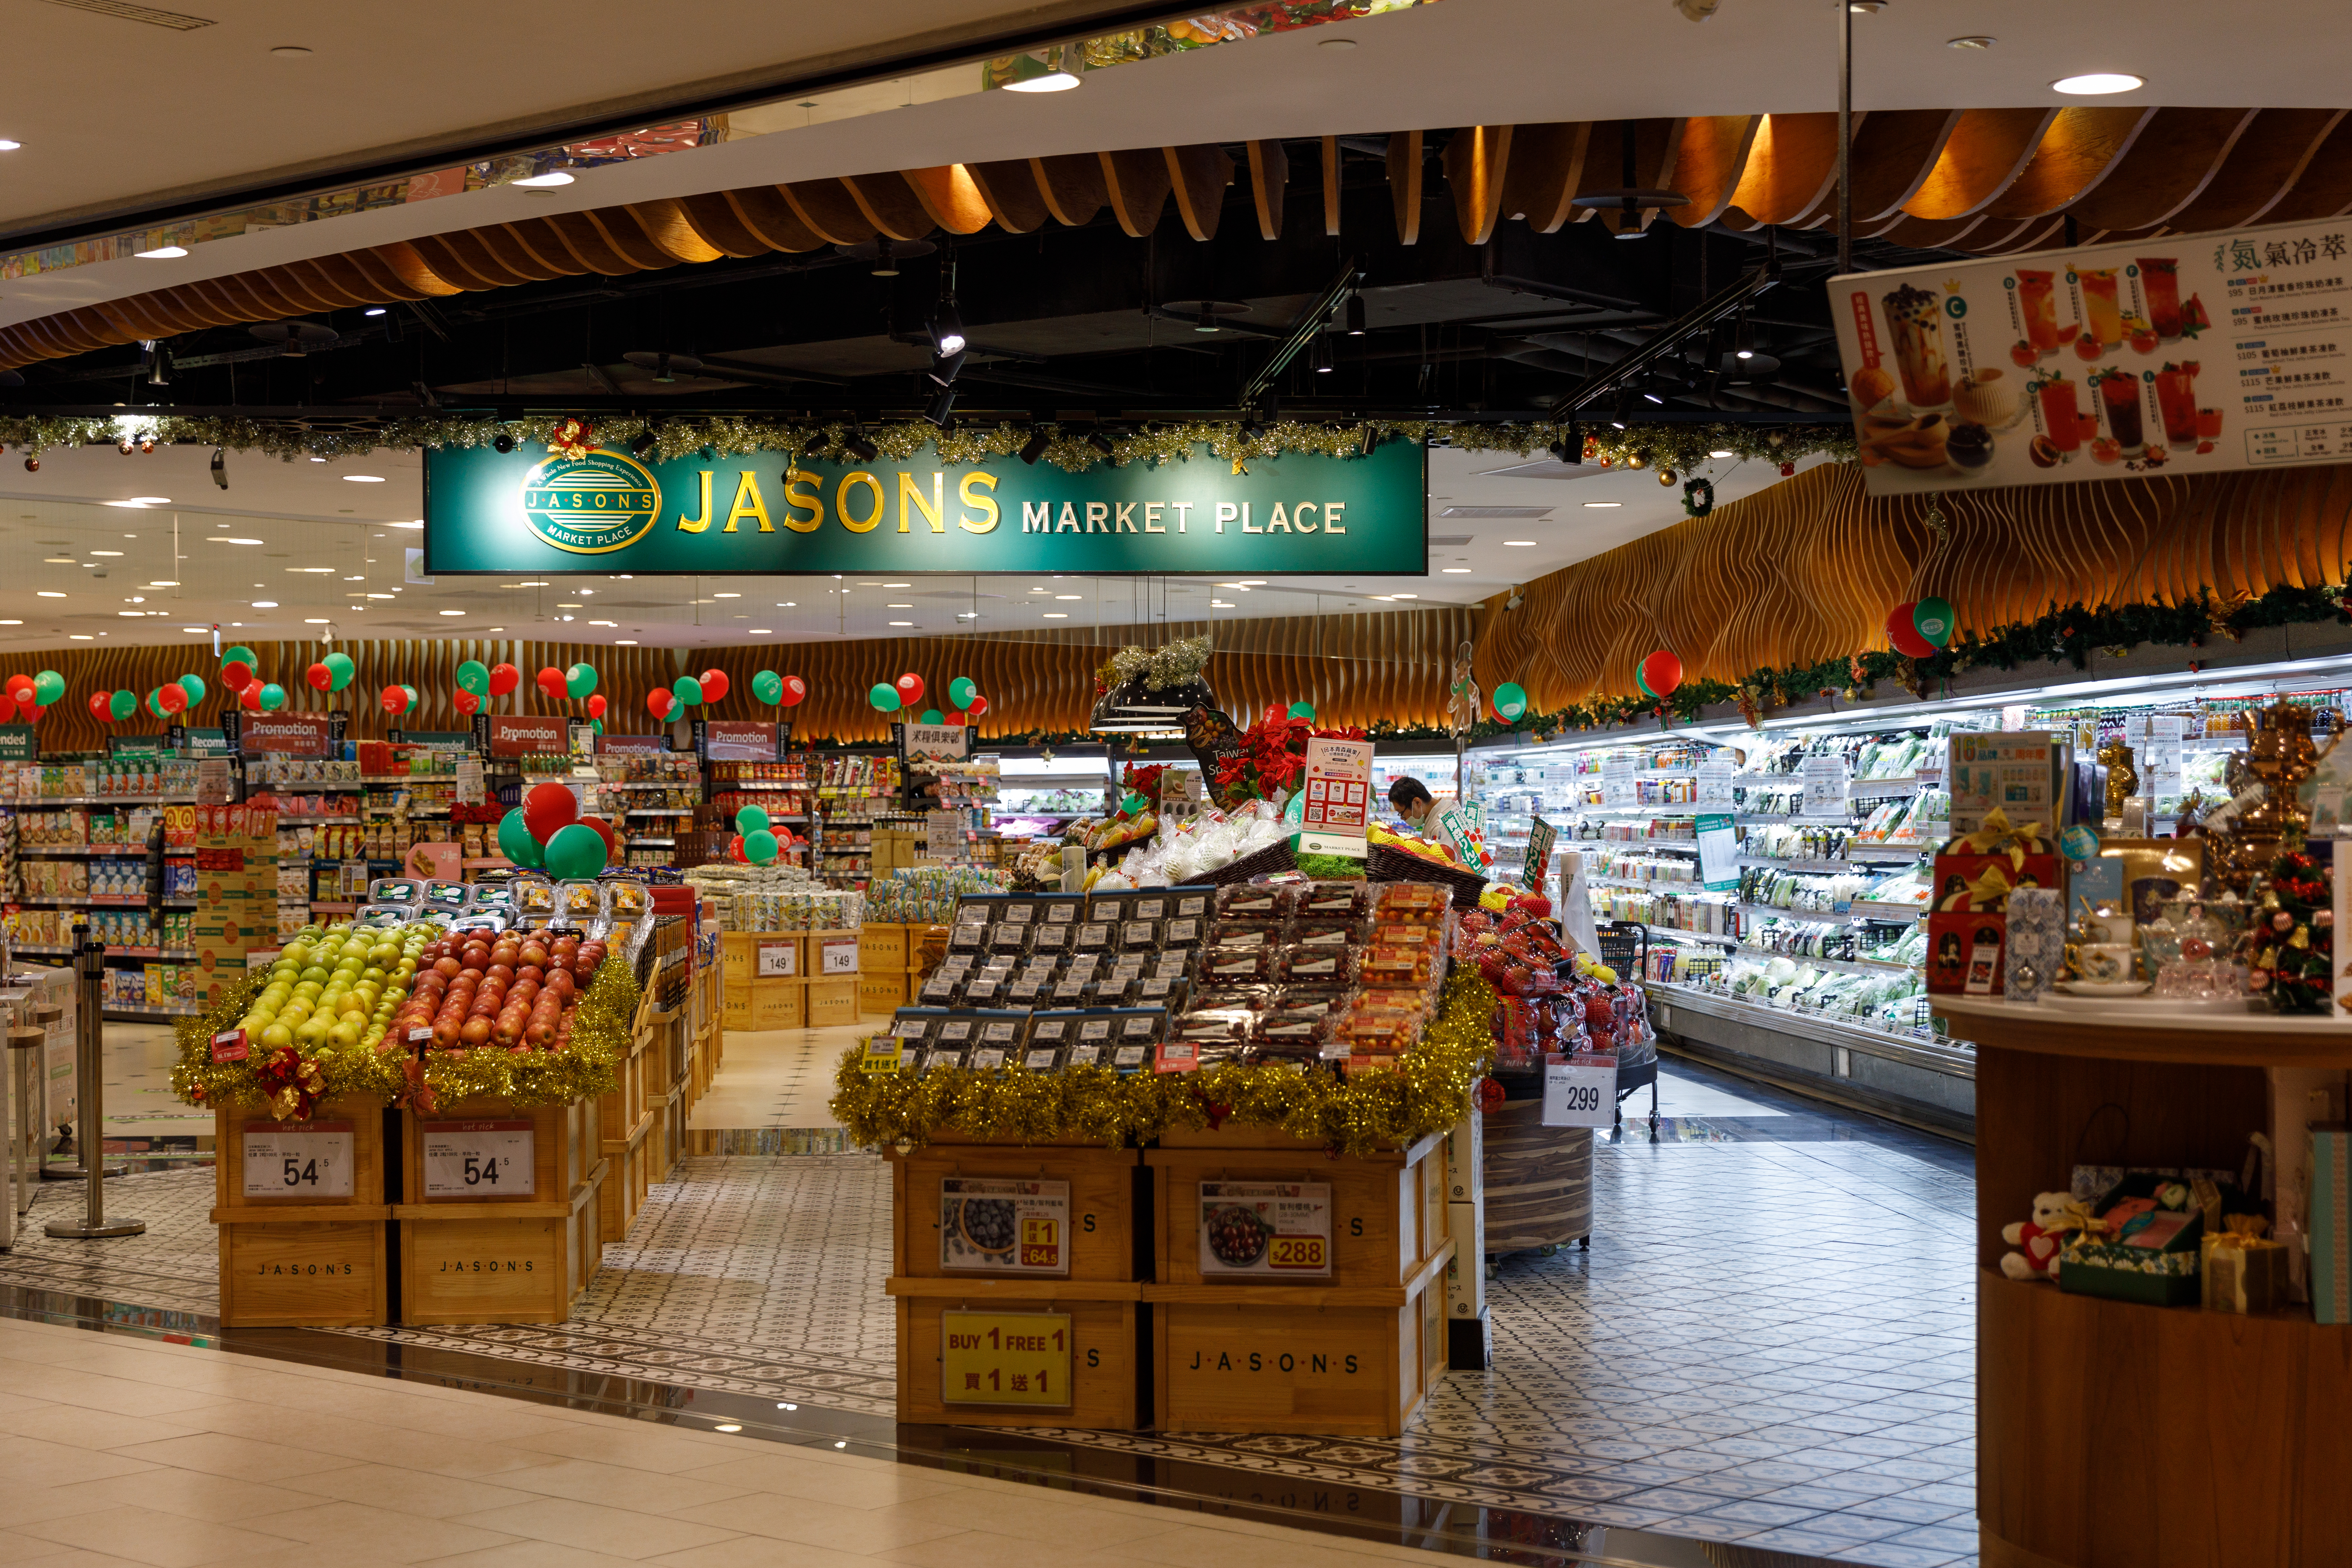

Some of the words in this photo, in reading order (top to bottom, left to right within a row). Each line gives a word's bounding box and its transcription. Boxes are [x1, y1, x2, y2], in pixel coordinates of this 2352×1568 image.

[2230, 234, 2347, 272] 氮氣冷萃
[2228, 288, 2243, 297] $95
[1950, 301, 1961, 315] C
[2233, 318, 2247, 326] $95
[2237, 351, 2257, 361] $105
[2241, 378, 2261, 387] $115
[2245, 405, 2264, 413] $115
[540, 468, 557, 481] Whole
[557, 462, 570, 472] New
[588, 459, 614, 470] Shopping
[615, 464, 643, 488] Experience
[677, 471, 1000, 534] JASONS
[1021, 501, 1195, 534] MARKET
[1216, 501, 1348, 535] PLACE
[546, 524, 592, 545] MARKET
[597, 526, 633, 545] PLACE
[253, 722, 317, 736] Promotion
[501, 726, 557, 740] Promotion
[716, 731, 768, 743] Promotion
[912, 730, 959, 744] 米糧俱樂部
[605, 743, 652, 754] Promotion
[1212, 748, 1248, 761] Taiwa
[1445, 816, 1482, 871] 青森りんご
[1524, 823, 1546, 885] 青森りんご
[654, 876, 681, 885] あみじゃが
[770, 957, 786, 970] 149
[834, 955, 850, 967] 149
[1567, 1086, 1599, 1111] 299
[282, 1123, 296, 1131] hot
[299, 1123, 314, 1132] pick
[462, 1122, 476, 1131] hot
[479, 1122, 494, 1131] pick
[1278, 1203, 1311, 1211] 智利櫻桃
[1041, 1222, 1052, 1243] 1
[1273, 1241, 1321, 1263] $288
[949, 1334, 981, 1349] BUY
[987, 1327, 1000, 1350] 1
[1006, 1335, 1046, 1351] FREE
[1051, 1328, 1064, 1352] 1
